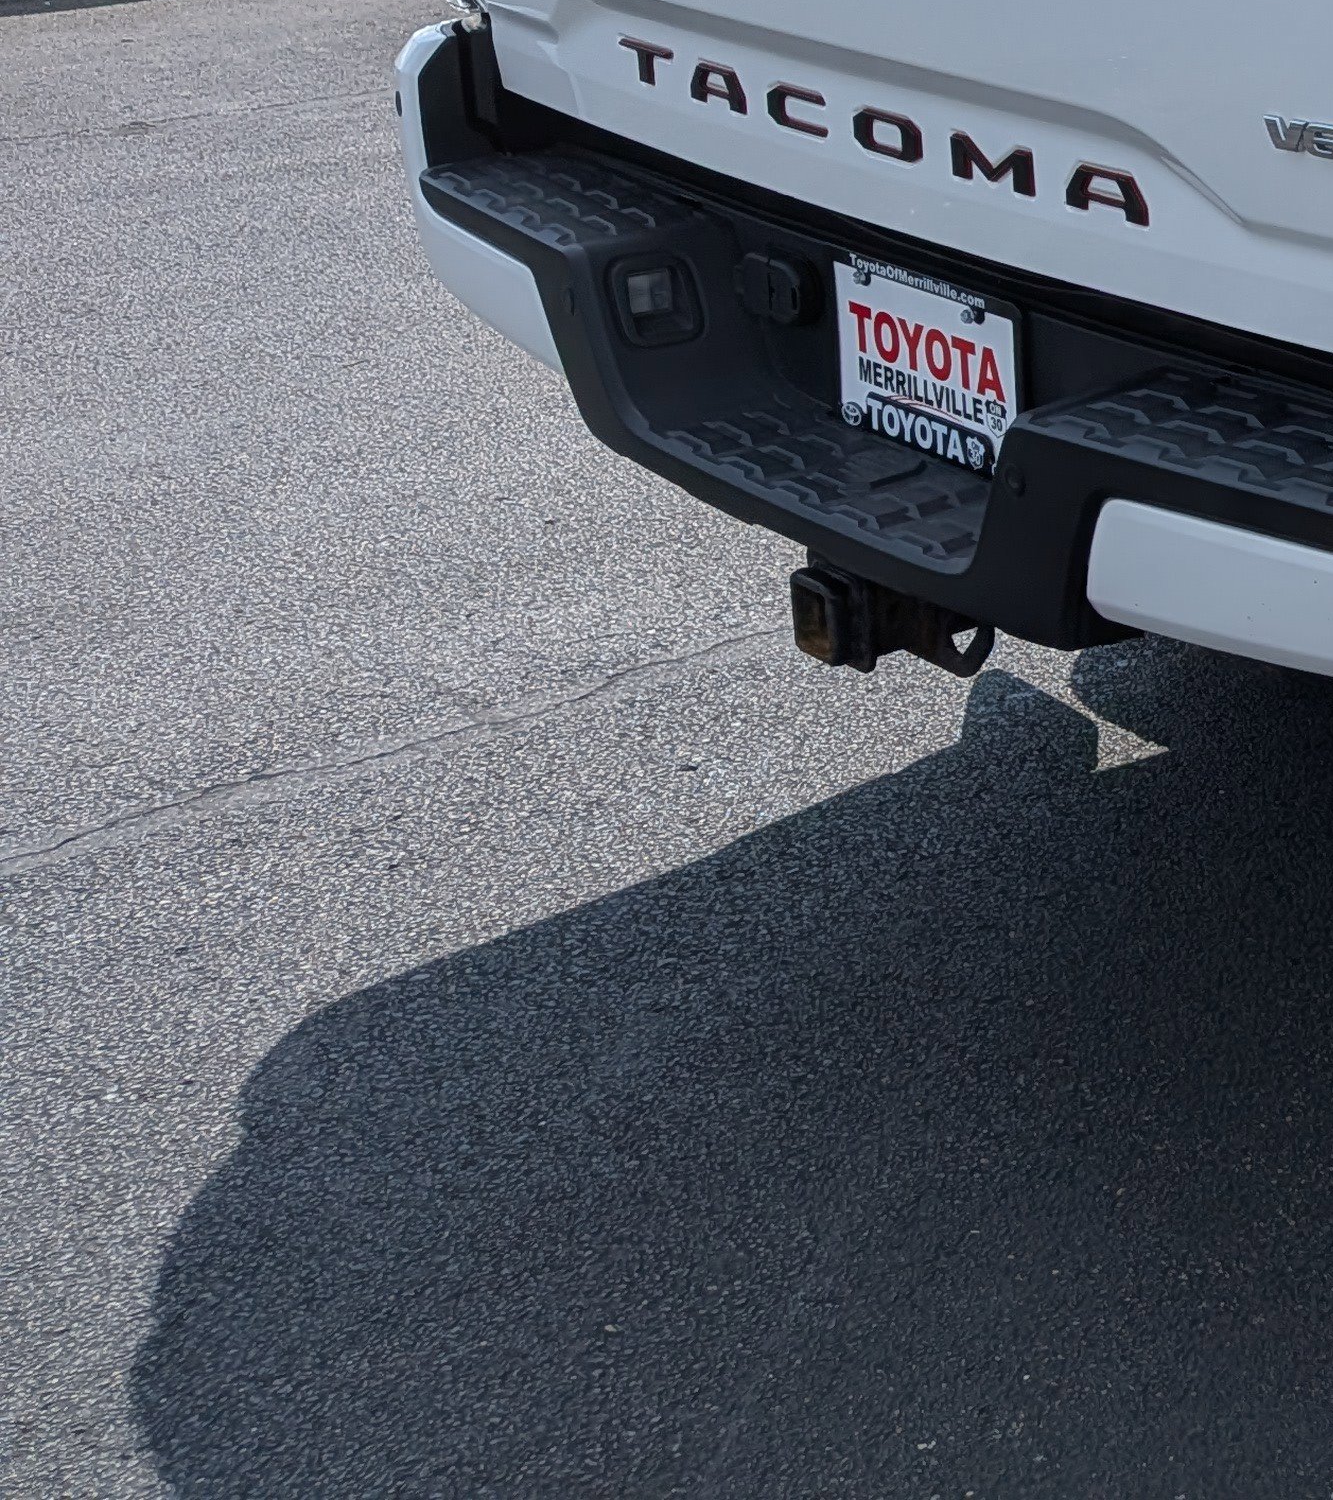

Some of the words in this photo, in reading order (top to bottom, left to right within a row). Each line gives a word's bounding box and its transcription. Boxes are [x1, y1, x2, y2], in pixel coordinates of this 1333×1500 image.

[618, 33, 1151, 230] TACOMA
[849, 253, 986, 309] ToyotaOfMerrillville.com
[848, 300, 1006, 403] TOYOTA
[858, 355, 984, 425] MERRILLVILLE
[990, 416, 1003, 432] 30
[866, 397, 966, 465] TOYOTA
